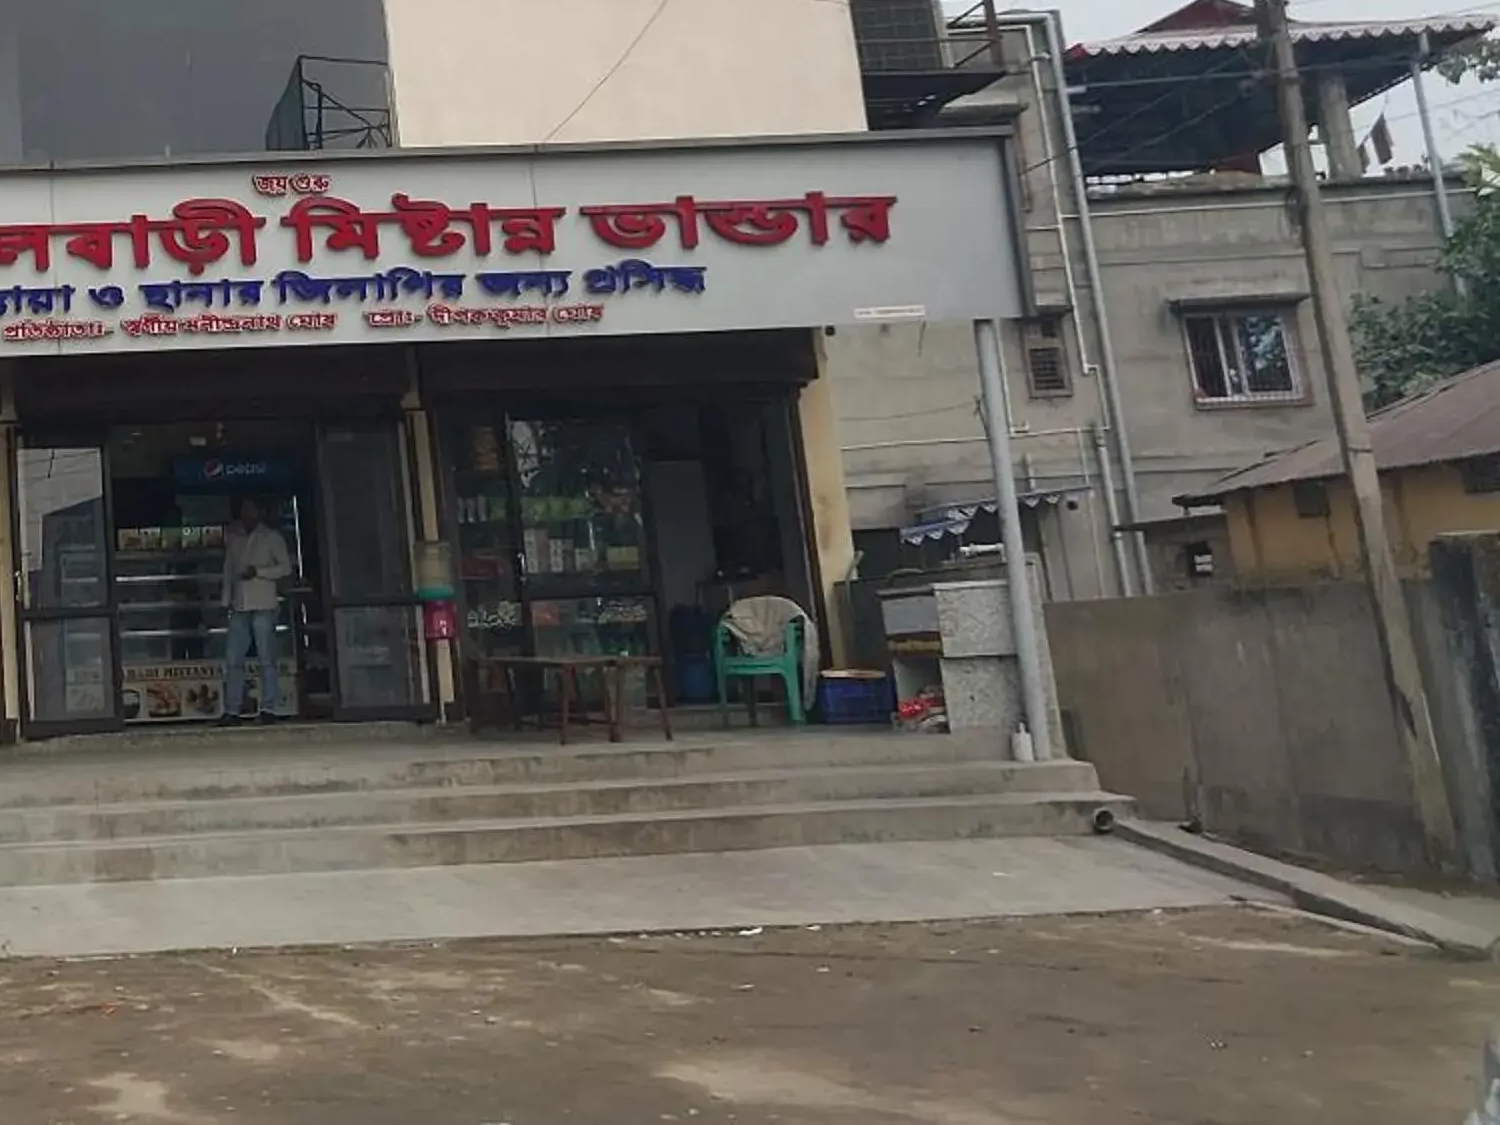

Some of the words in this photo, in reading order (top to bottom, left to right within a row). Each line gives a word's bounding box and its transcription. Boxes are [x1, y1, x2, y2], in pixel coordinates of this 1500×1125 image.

[280, 193, 566, 263] মিষ্টান্ন
[88, 283, 125, 309] ও
[138, 278, 264, 312] ছানার
